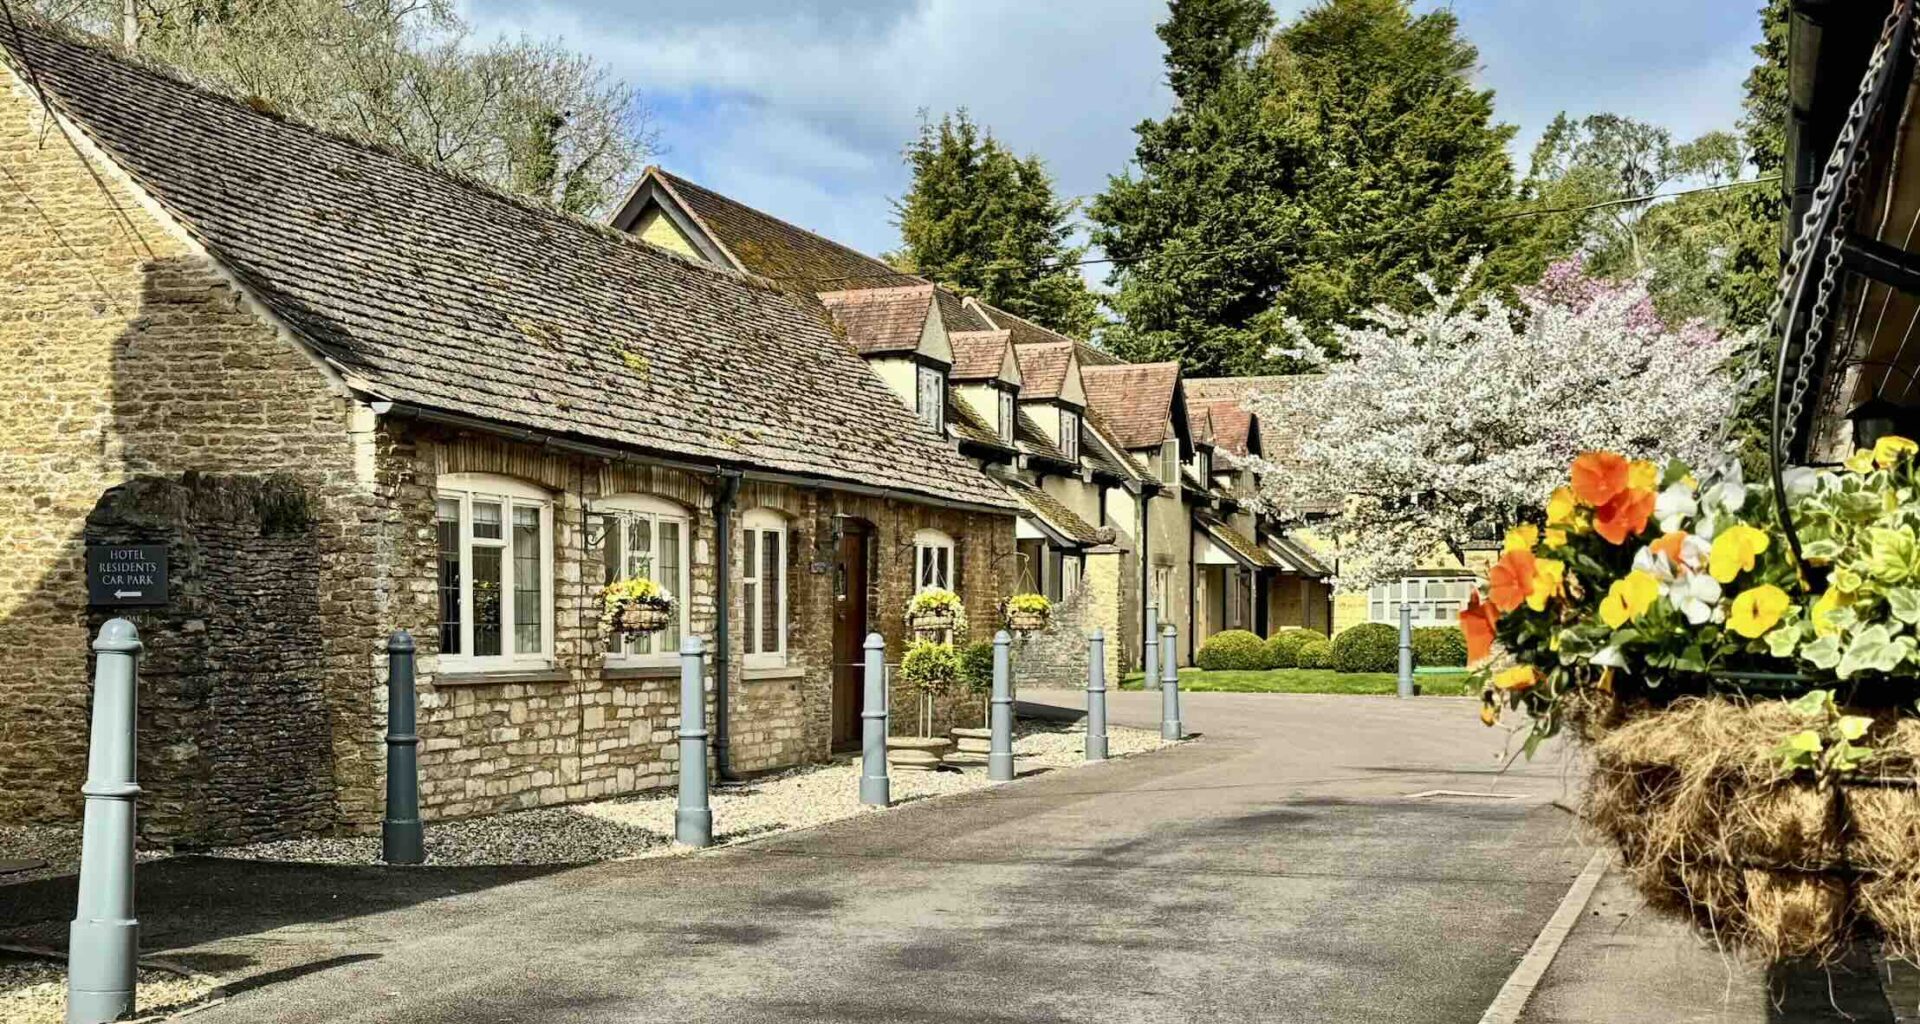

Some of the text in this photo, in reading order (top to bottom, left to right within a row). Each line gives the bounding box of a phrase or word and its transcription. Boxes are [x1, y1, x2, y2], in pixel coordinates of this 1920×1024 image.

[110, 549, 145, 560] HOTEL
[99, 562, 157, 573] RESIDENTS
[102, 574, 154, 585] CAR PARK
